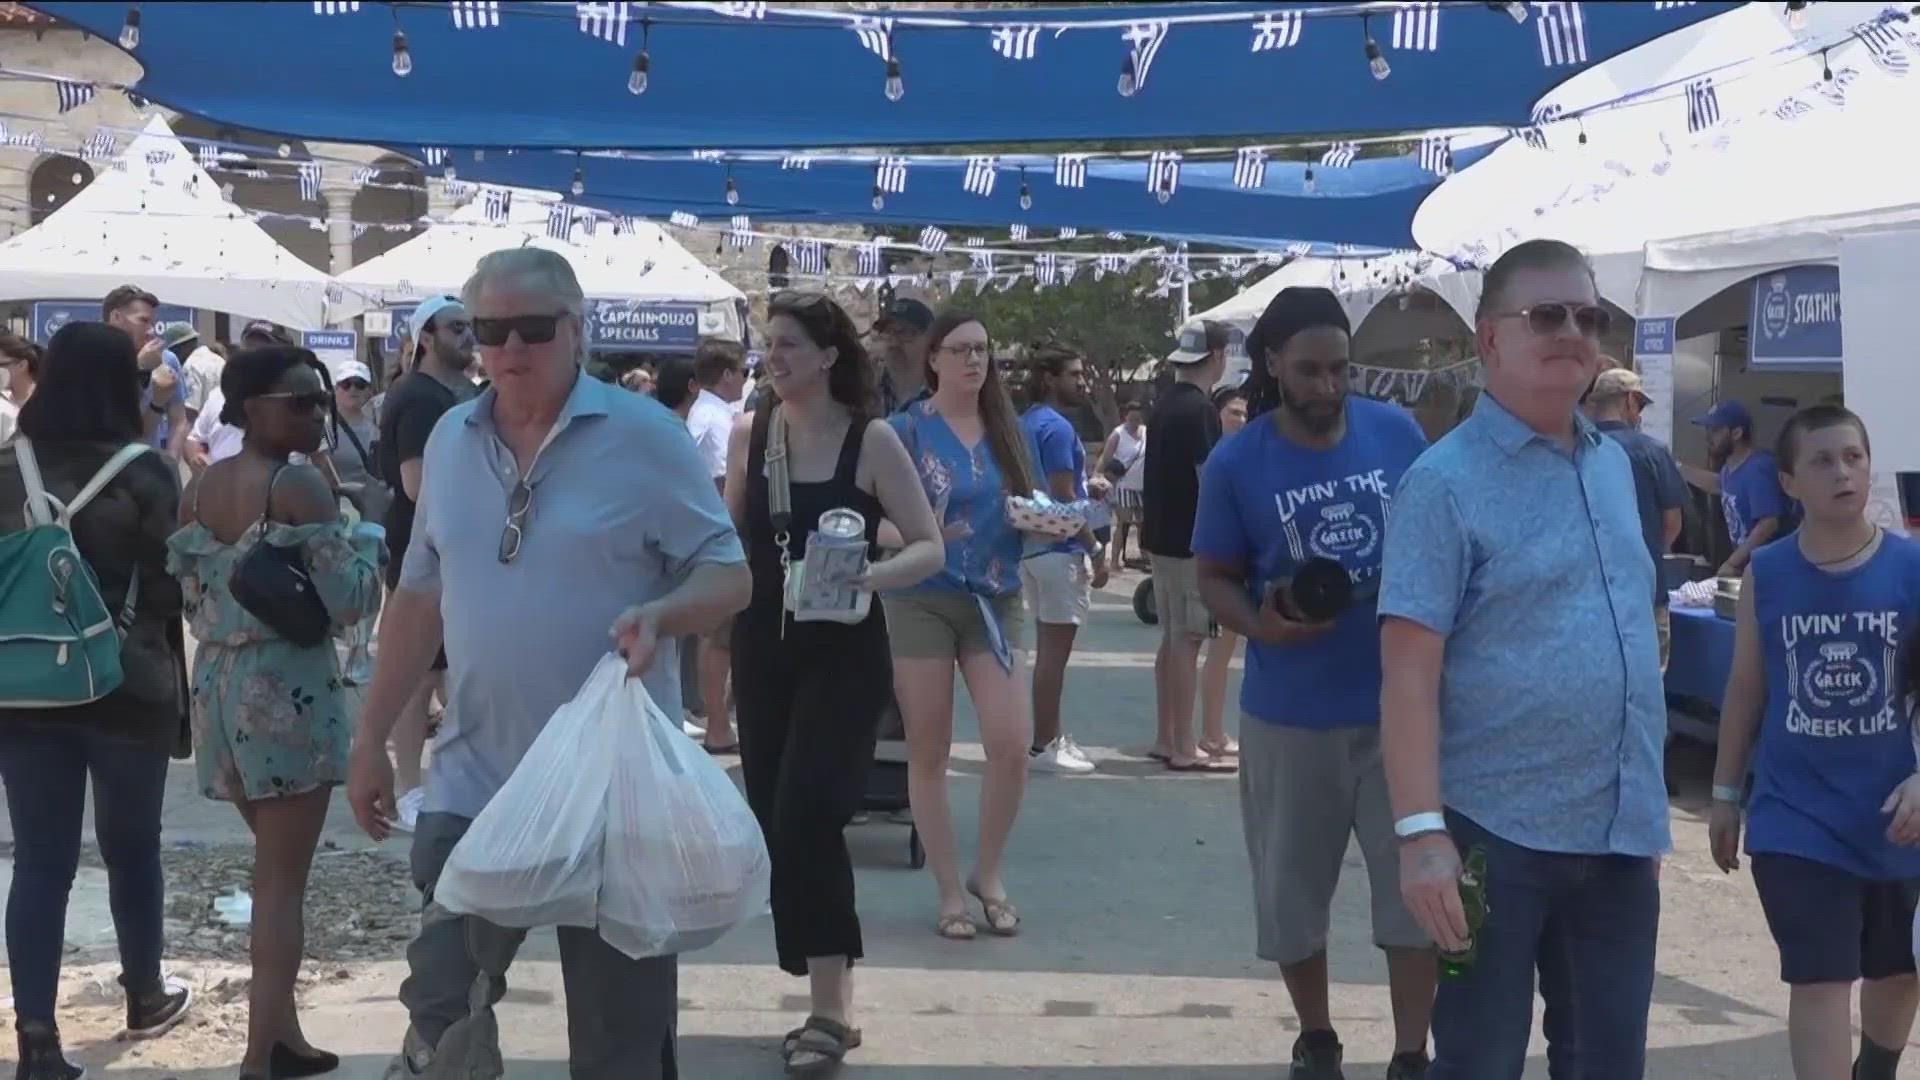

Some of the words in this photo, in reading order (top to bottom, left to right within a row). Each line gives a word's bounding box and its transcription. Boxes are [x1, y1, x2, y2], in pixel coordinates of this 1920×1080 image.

[309, 335, 350, 346] DRINKS
[599, 327, 659, 341] SPECIALS
[1344, 468, 1391, 500] THE
[1852, 611, 1899, 647] THE
[1786, 699, 1855, 738] GREEK
[1859, 695, 1898, 735] LIFE
